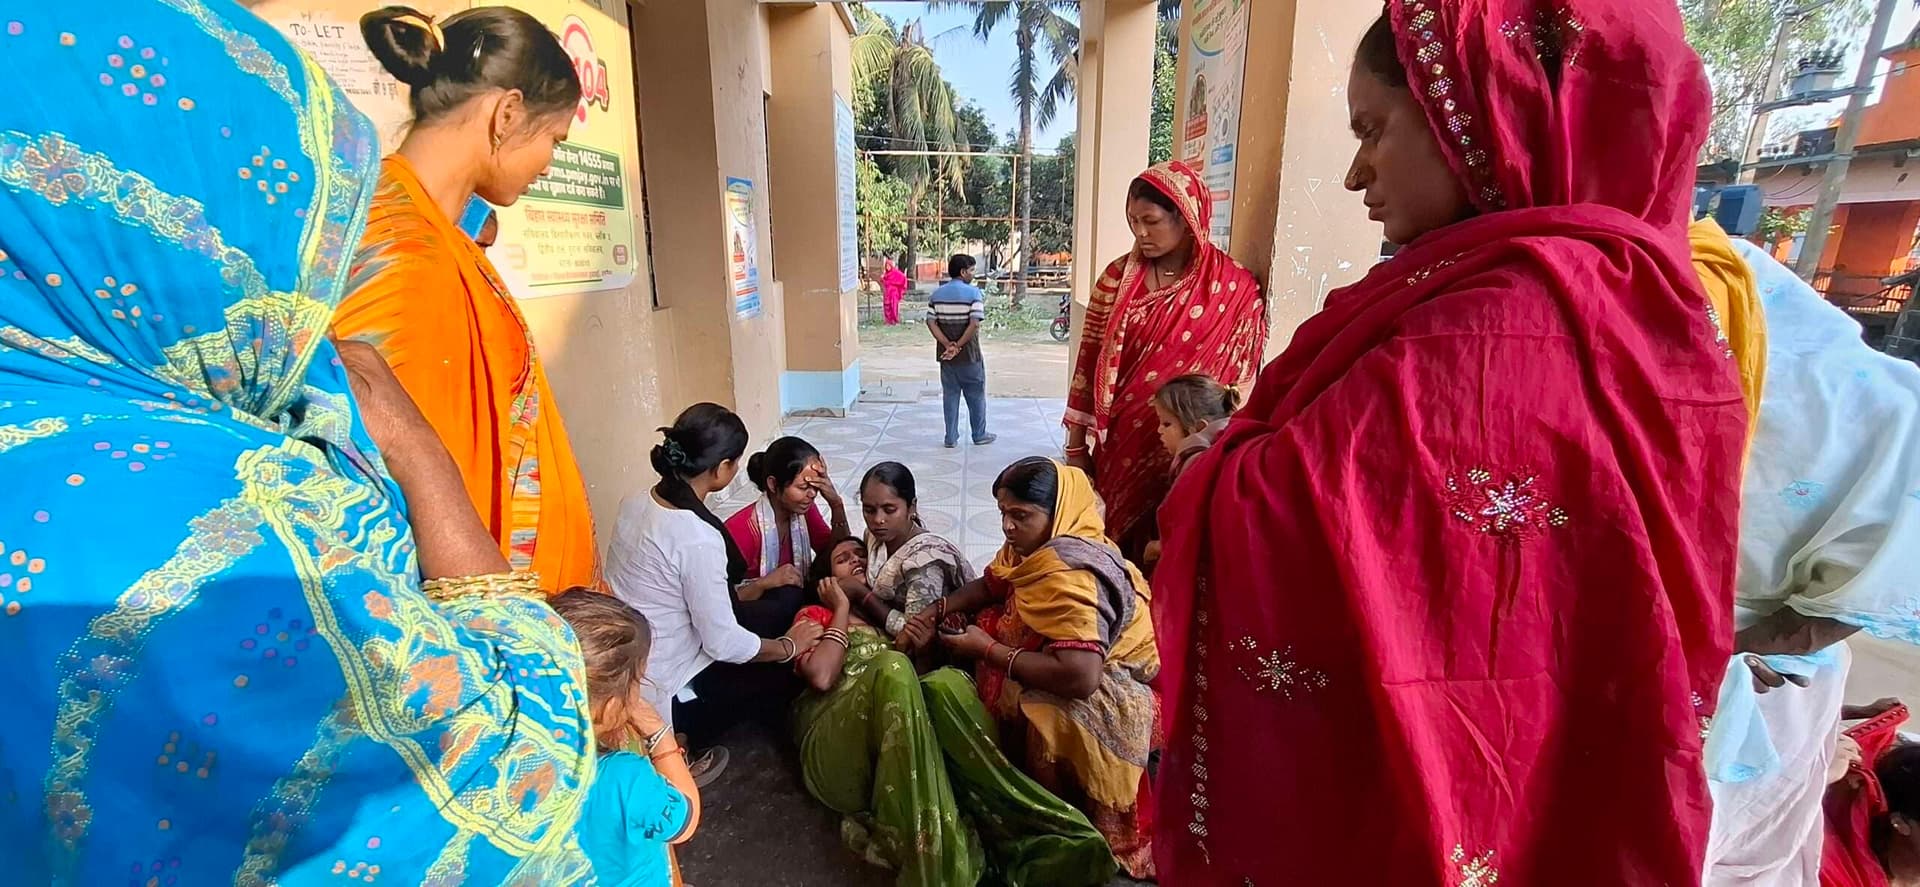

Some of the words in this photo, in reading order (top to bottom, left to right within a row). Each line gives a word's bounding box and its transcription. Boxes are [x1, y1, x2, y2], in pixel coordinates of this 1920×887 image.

[314, 24, 345, 39] LET
[577, 150, 601, 169] 14555
[524, 205, 545, 223] बिहार
[571, 212, 588, 228] सुरक्षा
[589, 210, 607, 226] समिति
